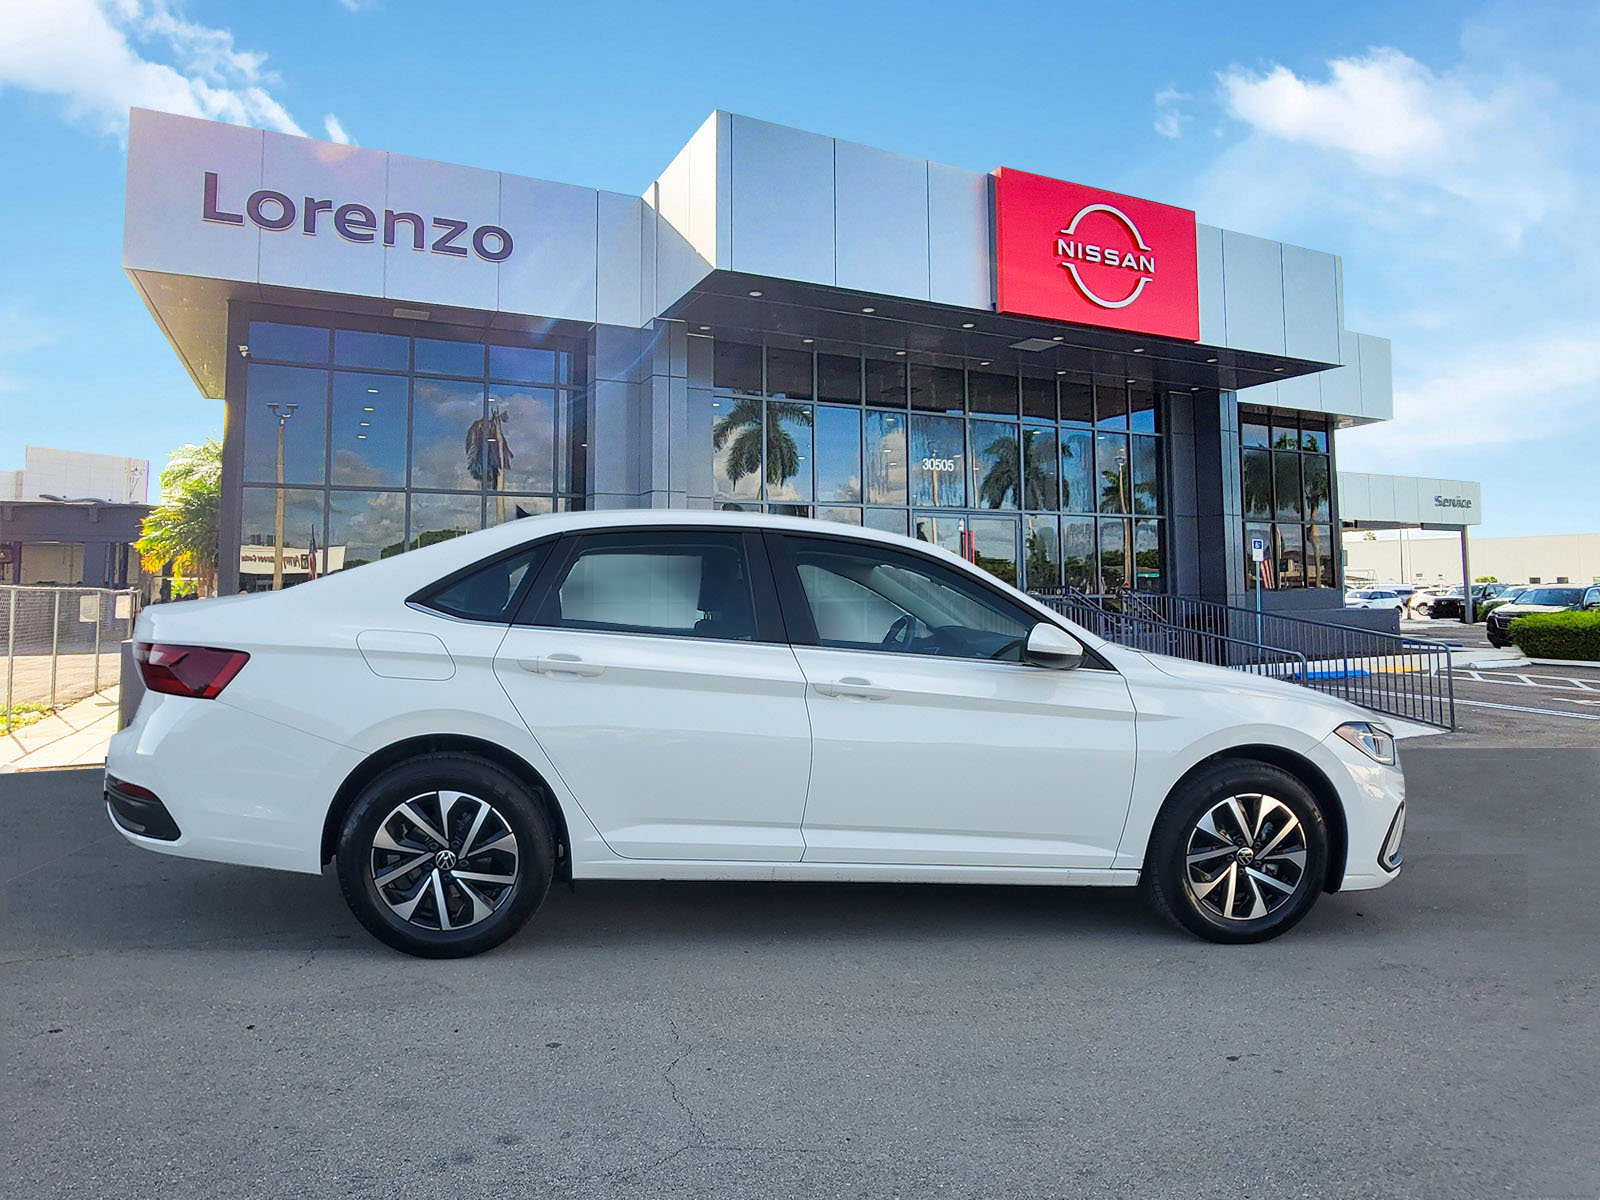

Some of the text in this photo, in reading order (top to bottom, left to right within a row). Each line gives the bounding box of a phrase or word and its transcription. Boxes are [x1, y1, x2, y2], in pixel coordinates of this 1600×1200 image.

[202, 171, 514, 262] Lorenzo
[1057, 238, 1155, 273] NISSAN
[922, 458, 955, 472] 30505
[1434, 495, 1472, 509] Service
